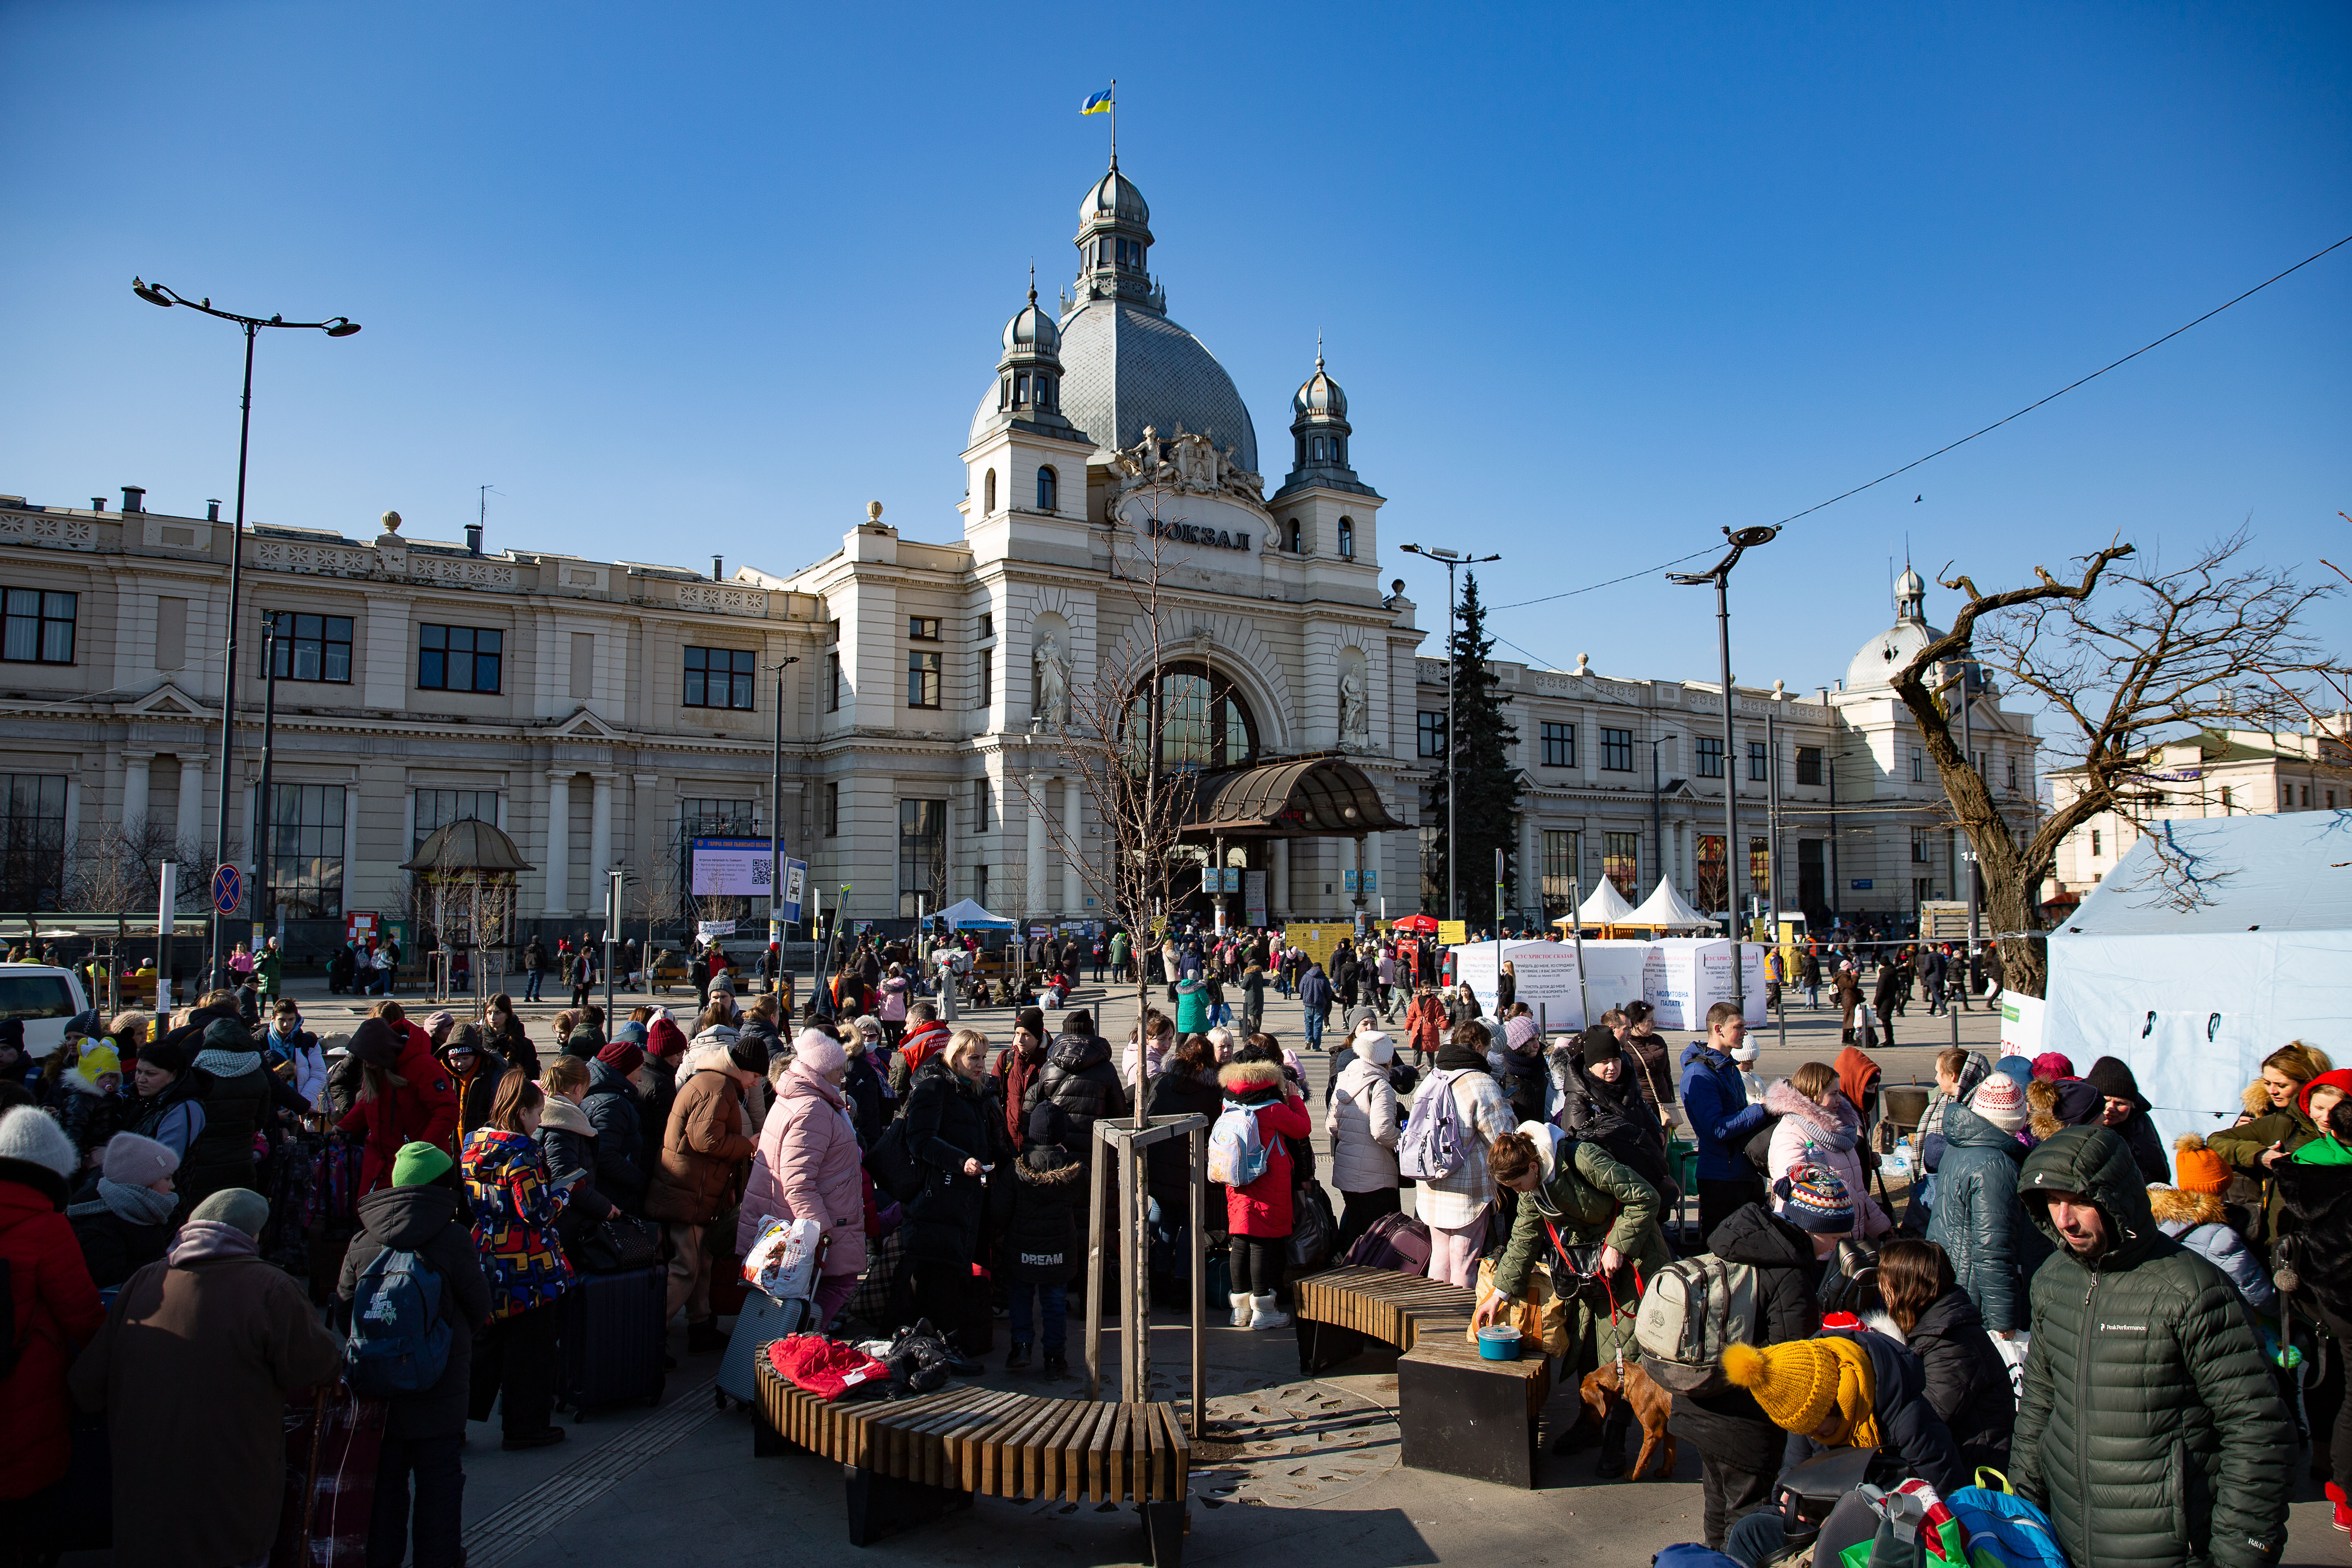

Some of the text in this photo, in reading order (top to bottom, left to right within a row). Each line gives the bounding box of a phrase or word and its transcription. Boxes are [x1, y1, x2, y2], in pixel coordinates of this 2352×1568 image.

[1148, 518, 1251, 551] ВОКЗАЛ
[1022, 1253, 1062, 1265] DREAM
[372, 1300, 392, 1310] theft
[363, 1310, 382, 1319] auto
[1649, 1309, 1665, 1326] BAGLAND
[1648, 1330, 1663, 1339] BAGLAND
[2247, 1538, 2265, 1549] R&D
